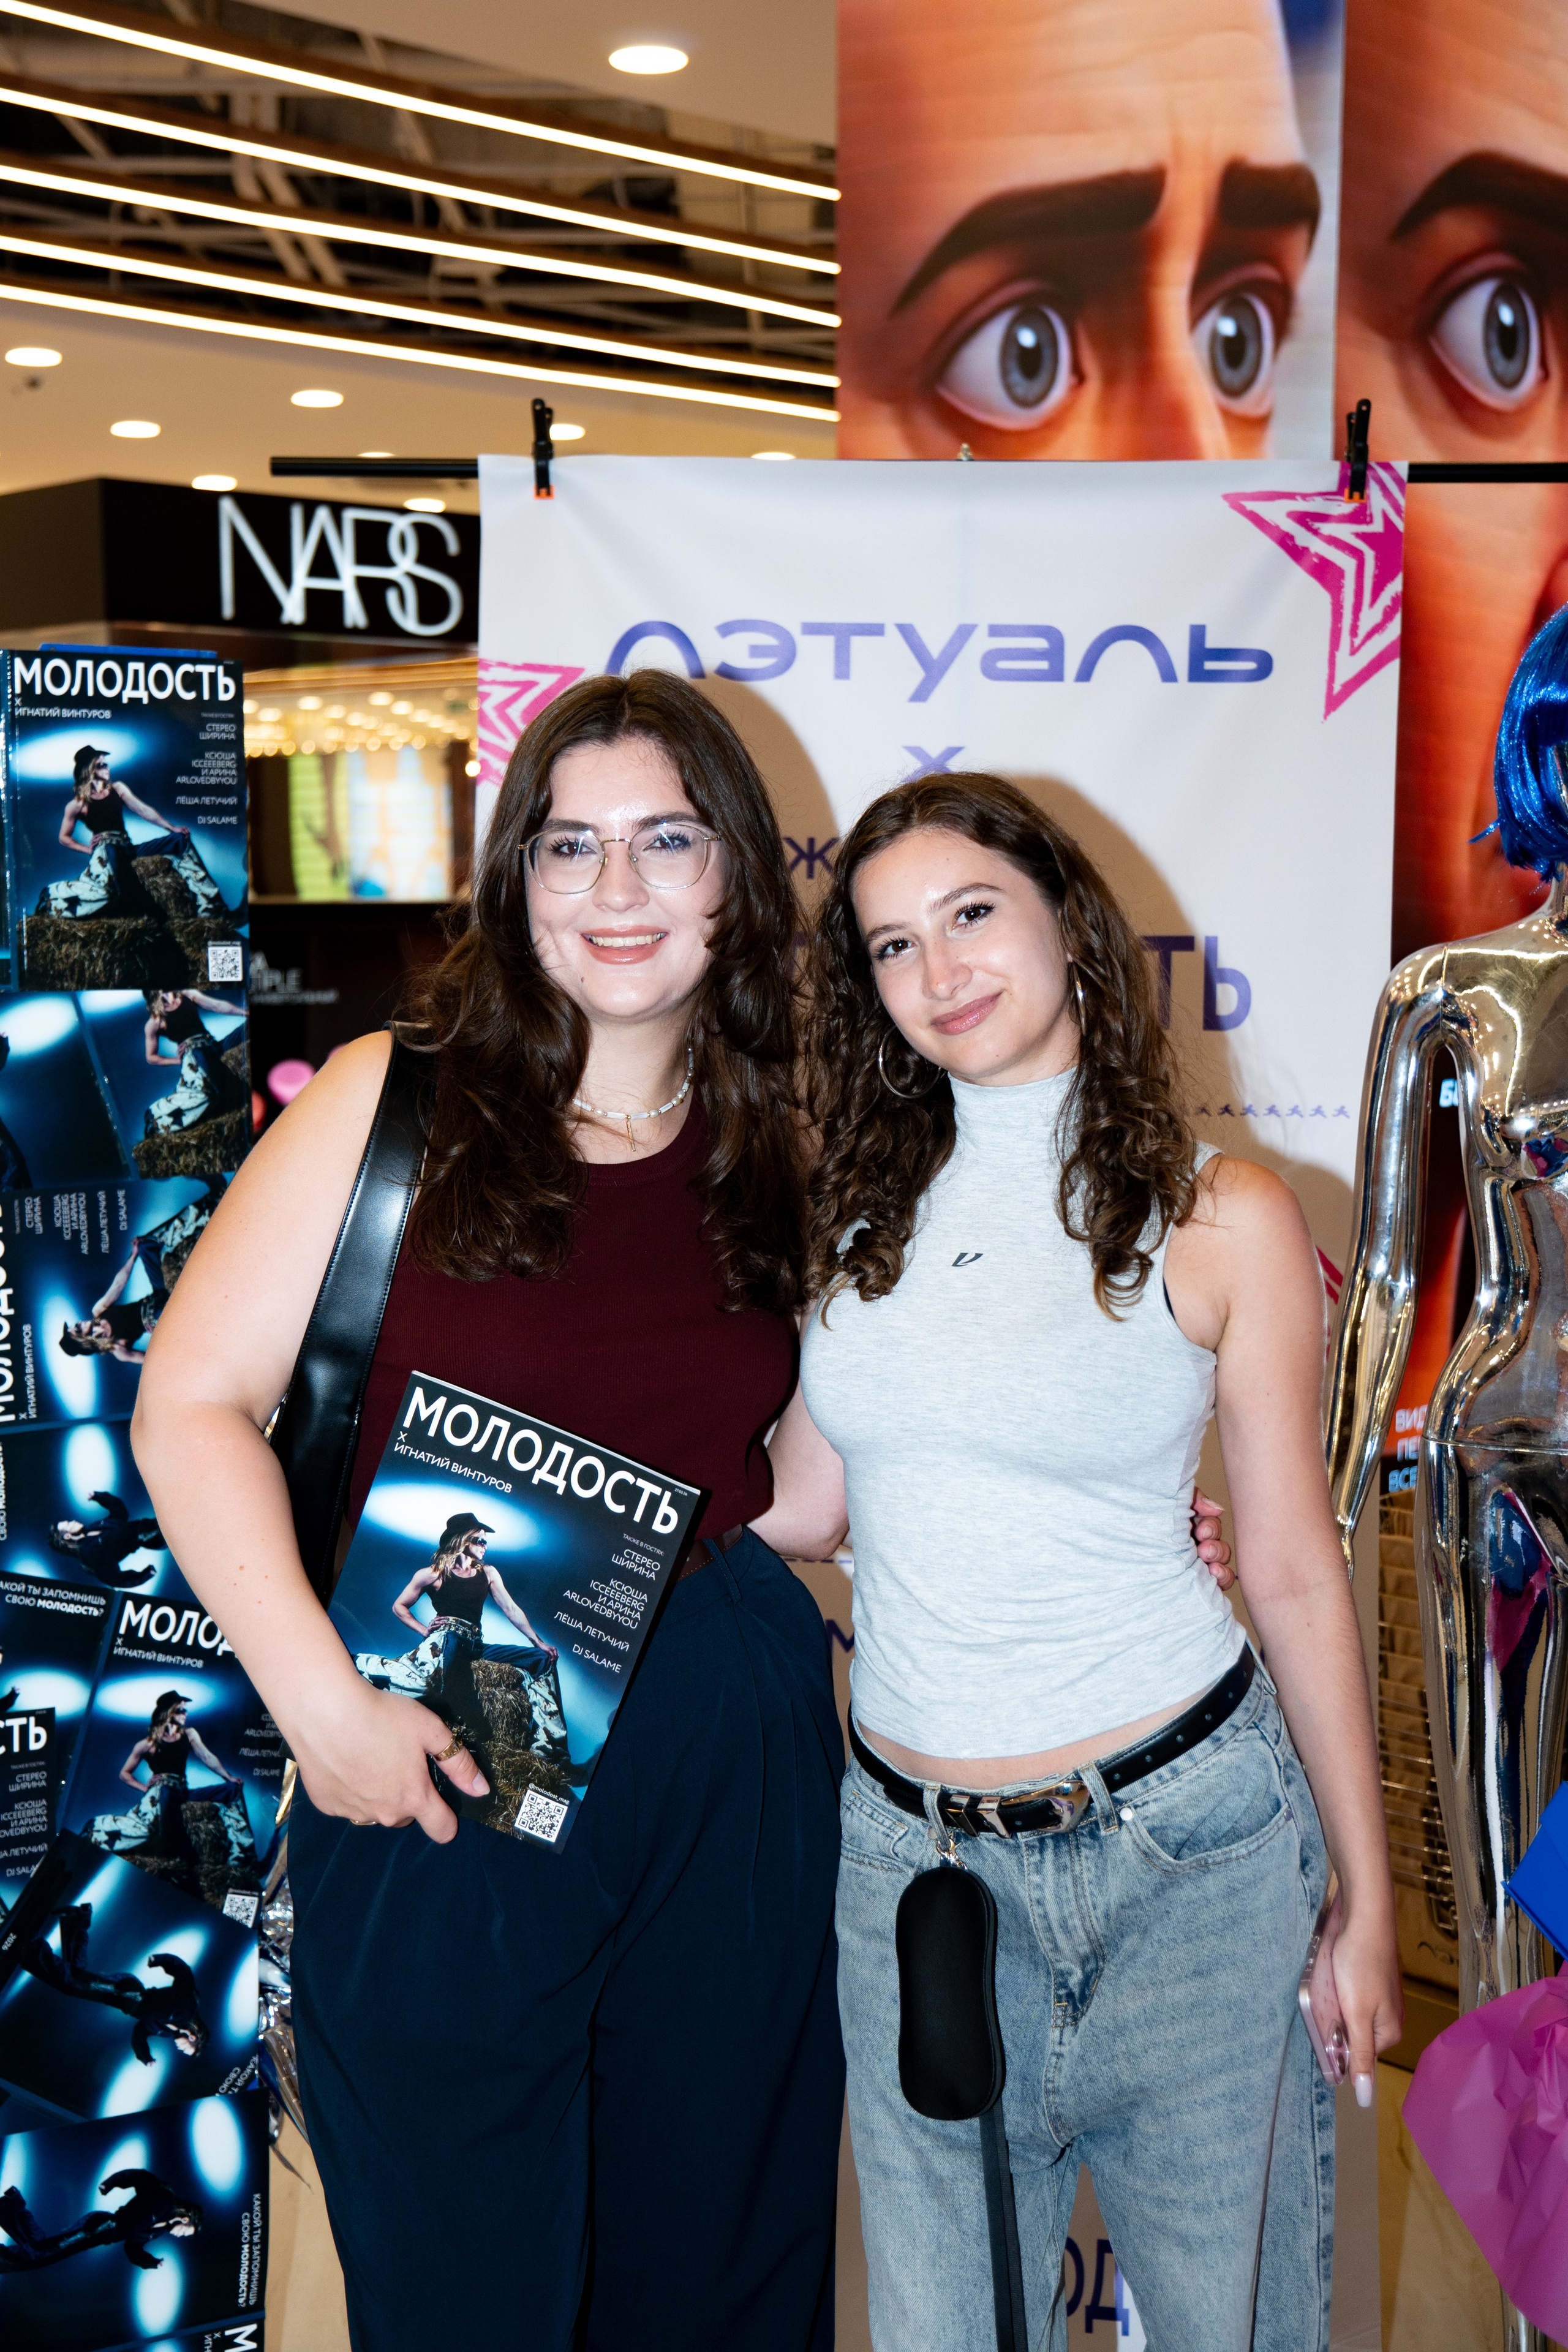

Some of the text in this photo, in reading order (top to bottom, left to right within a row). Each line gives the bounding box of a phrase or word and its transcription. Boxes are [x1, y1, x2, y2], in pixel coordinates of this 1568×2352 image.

[218, 494, 465, 637] NARS
[13, 657, 236, 704] МОЛОДОСТЬ
[15, 706, 112, 719] ИГНАТИЙ ВИНТУРОВ
[206, 724, 236, 733] СТЕРЕО
[191, 760, 238, 769] ICCEEEBERG
[205, 751, 237, 760] КСЮША
[175, 775, 238, 785] ARLOVEDBYYOU
[209, 768, 238, 777] АРИНА
[200, 796, 239, 805] ЛЕТУЧИЙ
[206, 816, 239, 825] SALAME
[24, 1196, 34, 1229] СТЕРЕО
[23, 1323, 37, 1419] ИГНАТИЙ ВИНТУРОВ
[394, 1442, 513, 1493] ИГНАТИЙ ВИНТУРОВ
[402, 1386, 679, 1534] МОЛОДОСТЬ
[623, 1533, 640, 1545] ТАКЖЕ
[611, 1553, 655, 1581] ШИРИНА
[624, 1549, 660, 1571] СТЕРЕО
[0, 1580, 107, 1606] АКОЙ ТЫ ЗАПОМНИШЬ
[590, 1580, 645, 1611] ICCEEEBERG
[609, 1578, 648, 1603] КСЮША
[5, 1594, 105, 1618] СВОЮ МОЛОДОСТЬ?
[563, 1589, 638, 1629] ARLOVEDBYYOU
[598, 1594, 641, 1621] И АРИНА
[554, 1611, 630, 1653] ЛЁША ЛЕТУЧИЙ
[113, 1646, 205, 1669] ИГНАТИЙ ВИНТУРОВ
[572, 1643, 622, 1673] DJ SALAME
[9, 1779, 48, 1792] ШИРИНА
[15, 1771, 48, 1783] СТЕРЕО
[14, 1798, 48, 1811] КСЮША
[529, 1782, 570, 1805] @molodost_mag
[19, 1815, 48, 1826] АРИНА
[9, 1842, 49, 1857] ЛЕТУЧИЙ
[238, 2212, 251, 2308] СВОЮ МОЛОДОСТЬ?
[249, 2193, 263, 2306] КАКОЙ ТЫ ЗАПОМНИШЬ
